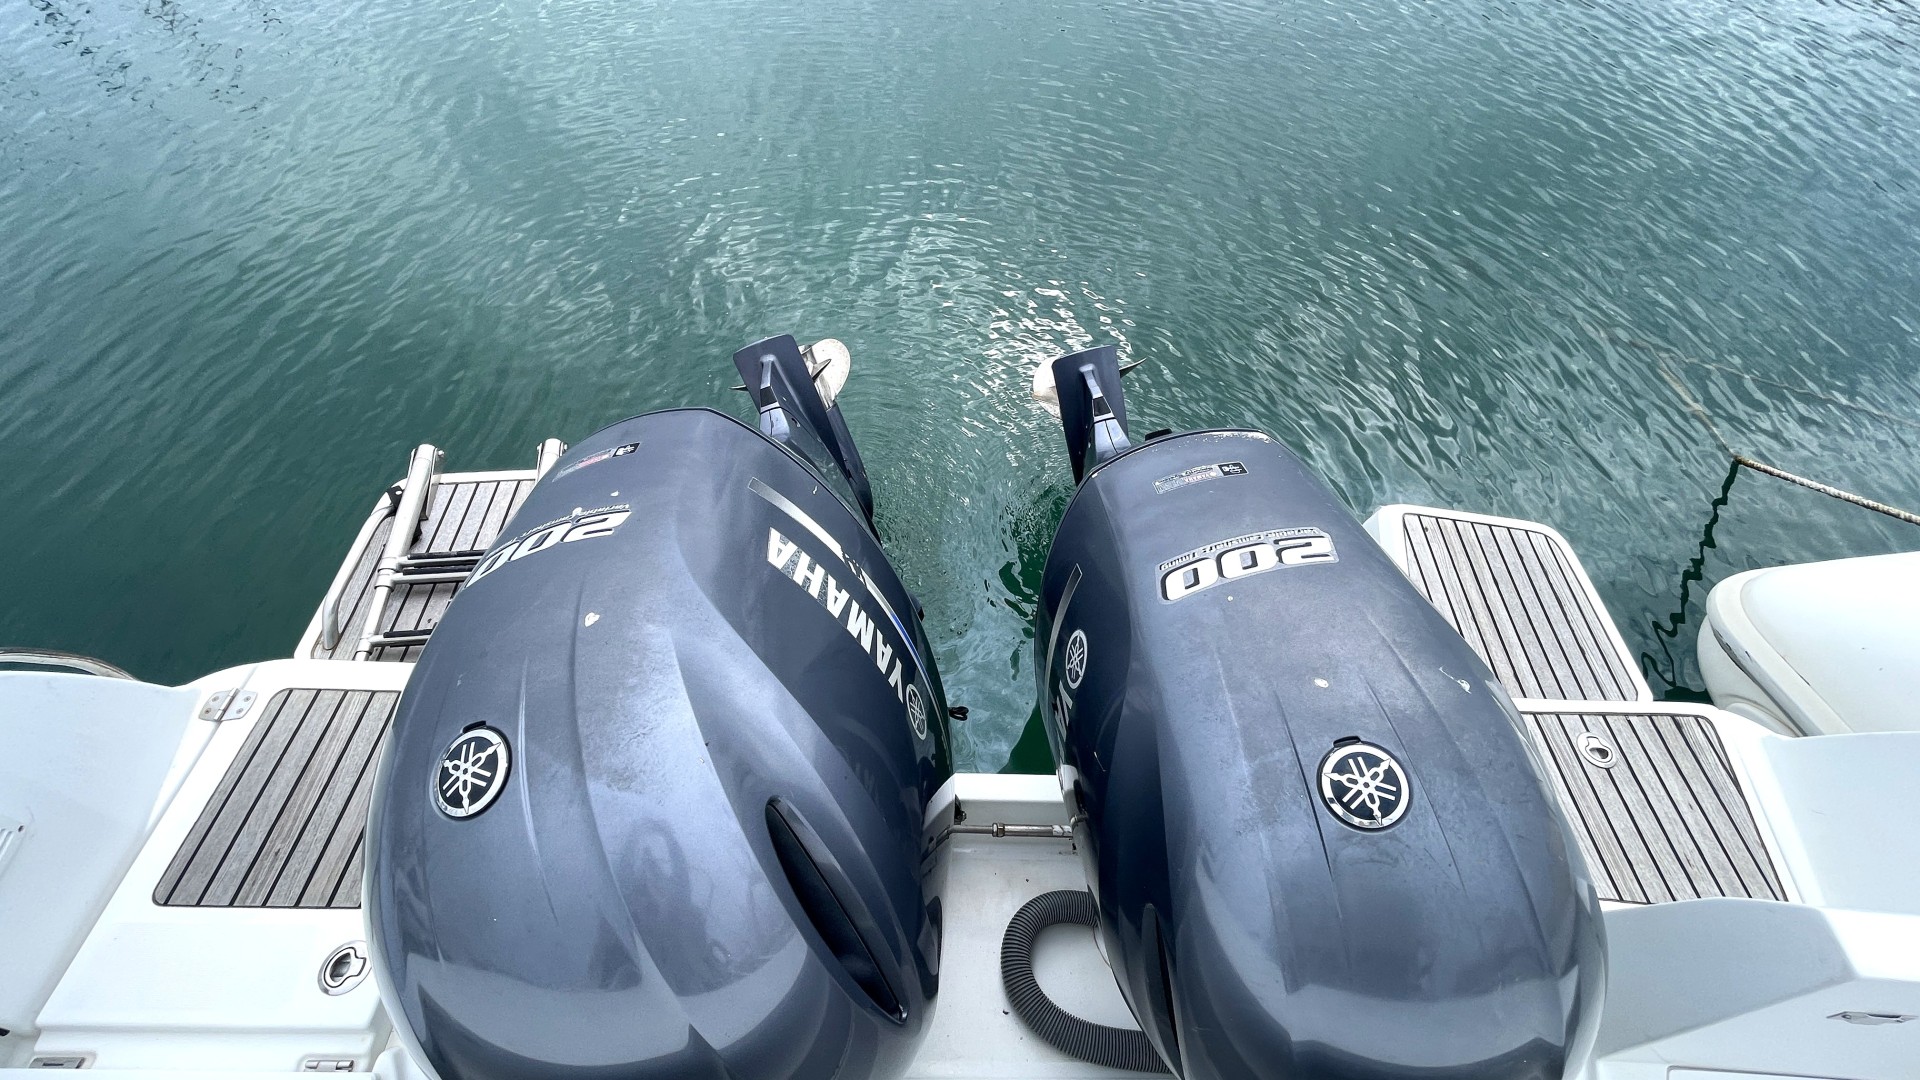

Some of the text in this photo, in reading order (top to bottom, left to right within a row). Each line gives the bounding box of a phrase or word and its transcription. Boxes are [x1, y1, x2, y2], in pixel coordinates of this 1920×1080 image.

[466, 510, 632, 588] 200
[1159, 528, 1319, 571] Variable Camshaft Timing
[1160, 534, 1335, 601] 200
[767, 526, 904, 704] YAMAHA
